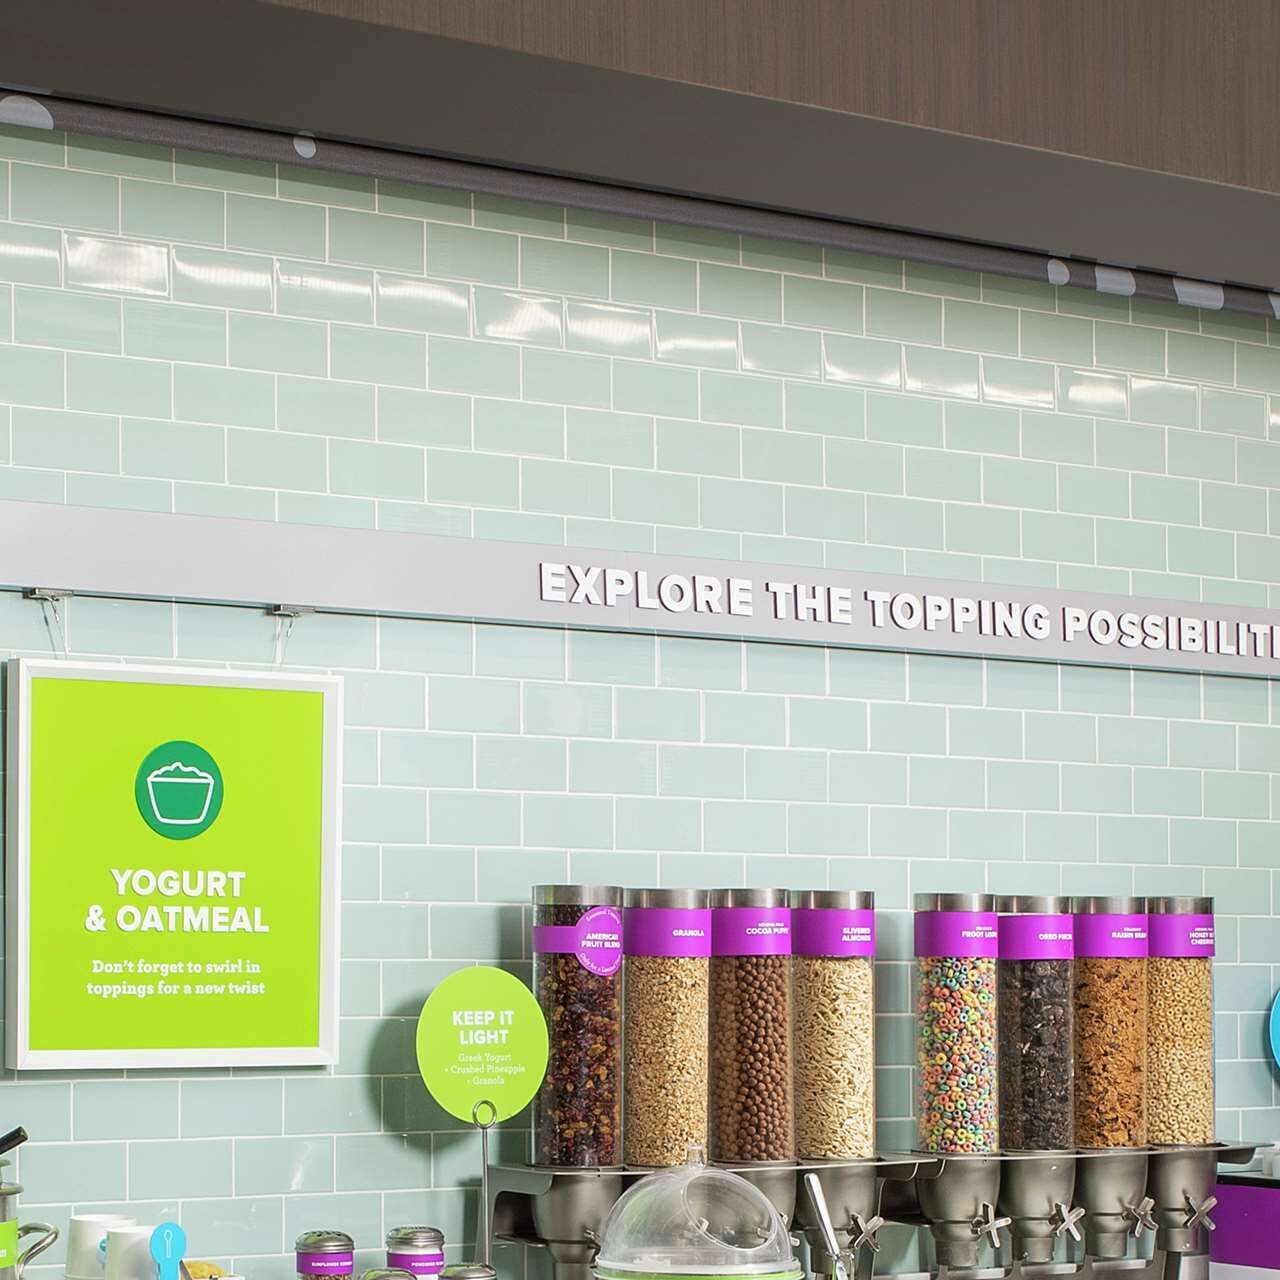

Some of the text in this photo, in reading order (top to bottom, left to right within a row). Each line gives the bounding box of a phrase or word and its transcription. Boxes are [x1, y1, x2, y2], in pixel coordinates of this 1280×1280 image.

[539, 561, 753, 617] EXPLORE
[766, 580, 853, 624] THE
[864, 588, 1050, 640] TOPPING
[111, 869, 246, 897] YOGURT
[85, 904, 269, 932] & OATMEAL
[673, 929, 704, 937] GRANOLA
[746, 927, 773, 935] COCOA
[581, 940, 603, 948] FRUIT
[92, 959, 261, 976] Don't forget to swirl in
[87, 980, 265, 998] toppings for a new twist
[452, 1010, 514, 1026] KEEP IT
[460, 1030, 508, 1045] LIGHT
[458, 1053, 511, 1063] Greek Yogurt
[451, 1064, 526, 1074] Crushed Pineapple
[473, 1076, 504, 1085] Granola
